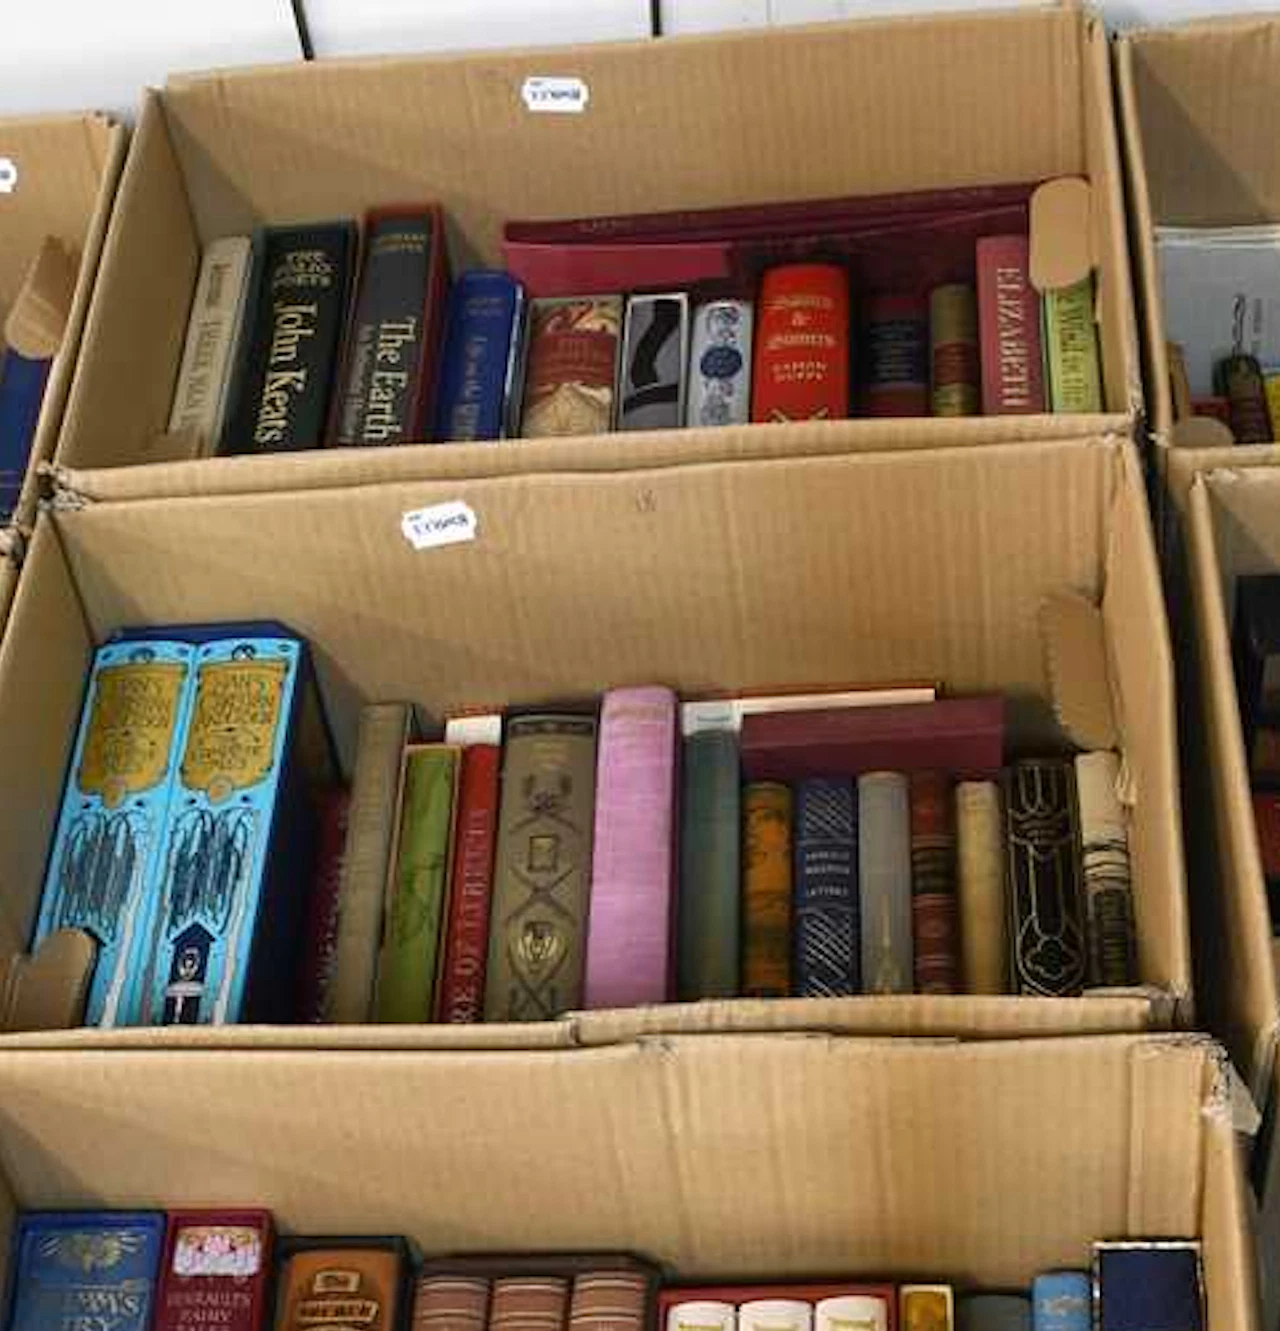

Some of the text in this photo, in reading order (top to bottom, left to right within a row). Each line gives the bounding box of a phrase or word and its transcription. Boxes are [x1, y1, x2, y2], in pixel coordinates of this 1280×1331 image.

[273, 300, 319, 364] John
[362, 315, 418, 440] The Earth
[995, 266, 1030, 408] ELIZABETH
[253, 368, 308, 444] Keats
